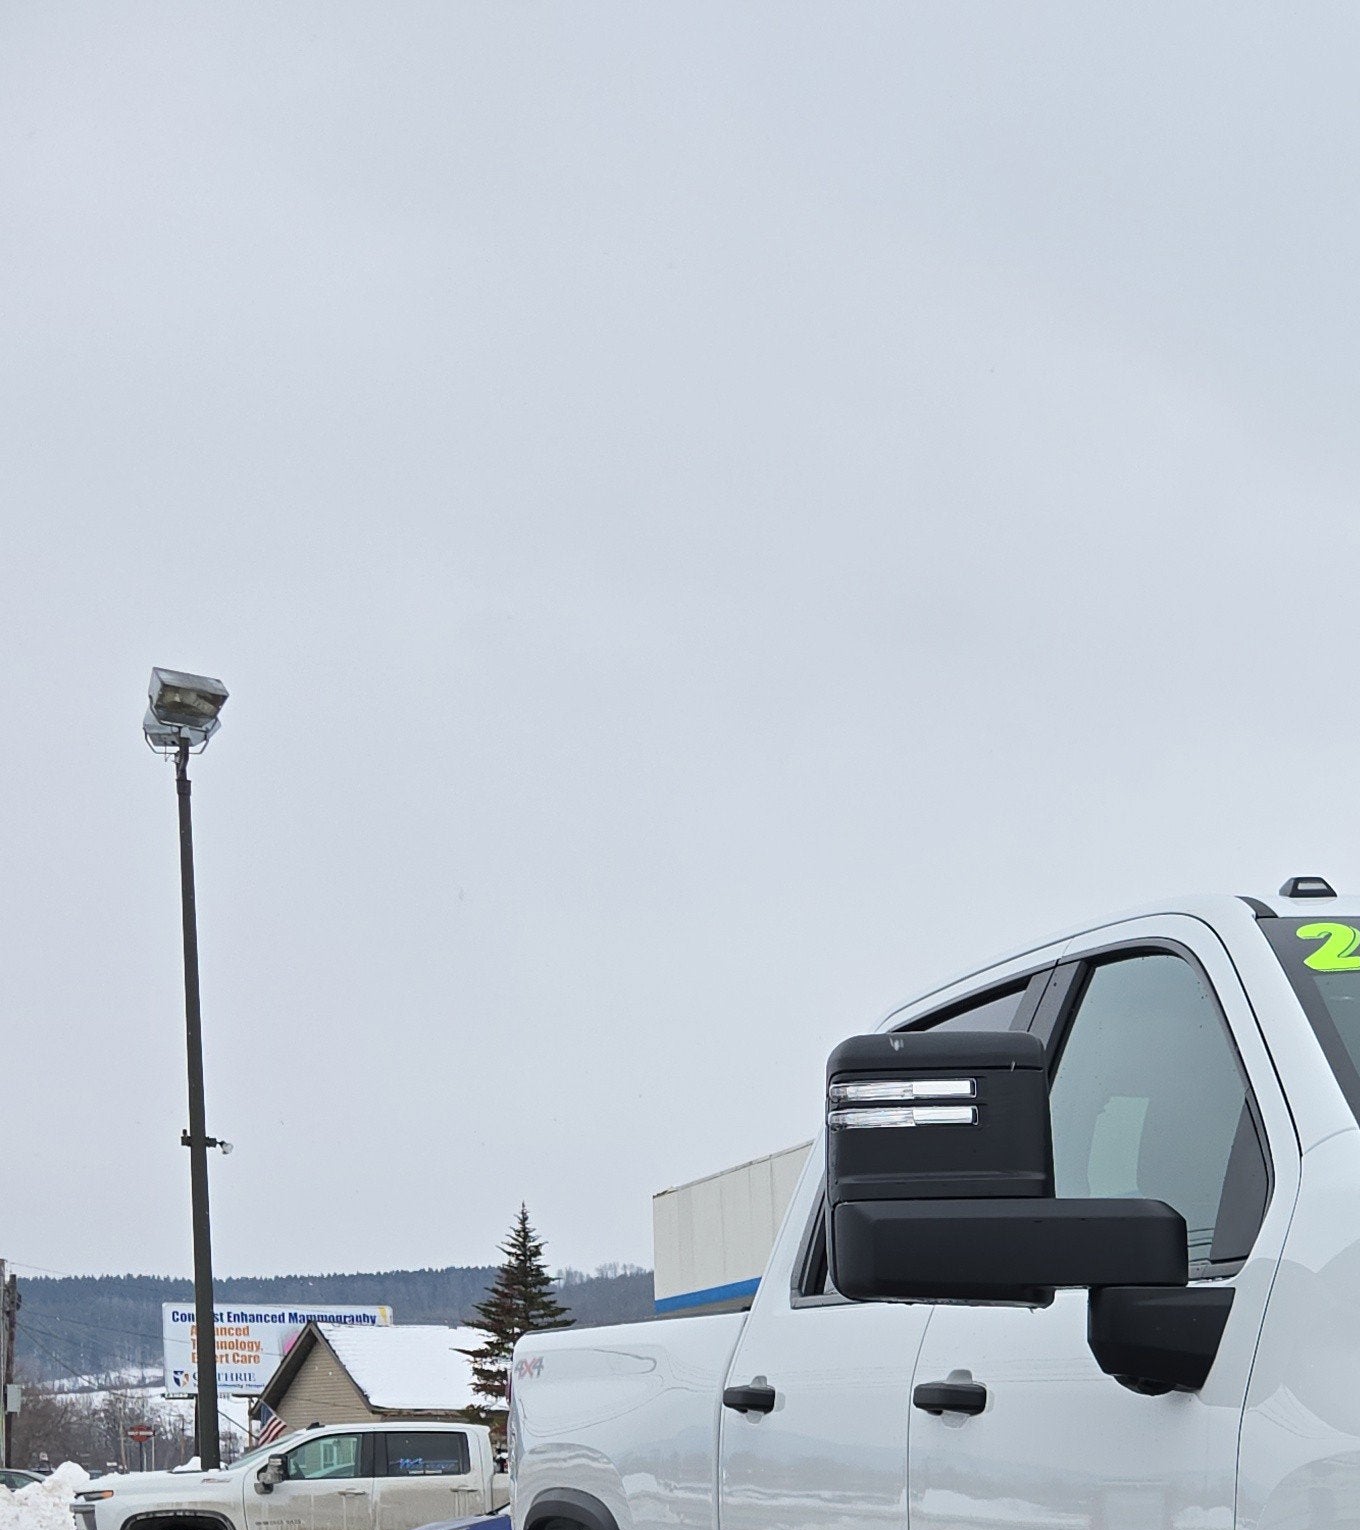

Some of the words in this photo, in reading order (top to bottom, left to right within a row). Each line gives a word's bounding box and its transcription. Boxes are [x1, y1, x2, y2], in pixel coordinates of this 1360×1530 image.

[172, 1311, 224, 1323] Const
[227, 1312, 286, 1324] Enhanced
[190, 1325, 250, 1337] Anced
[232, 1352, 261, 1365] Care
